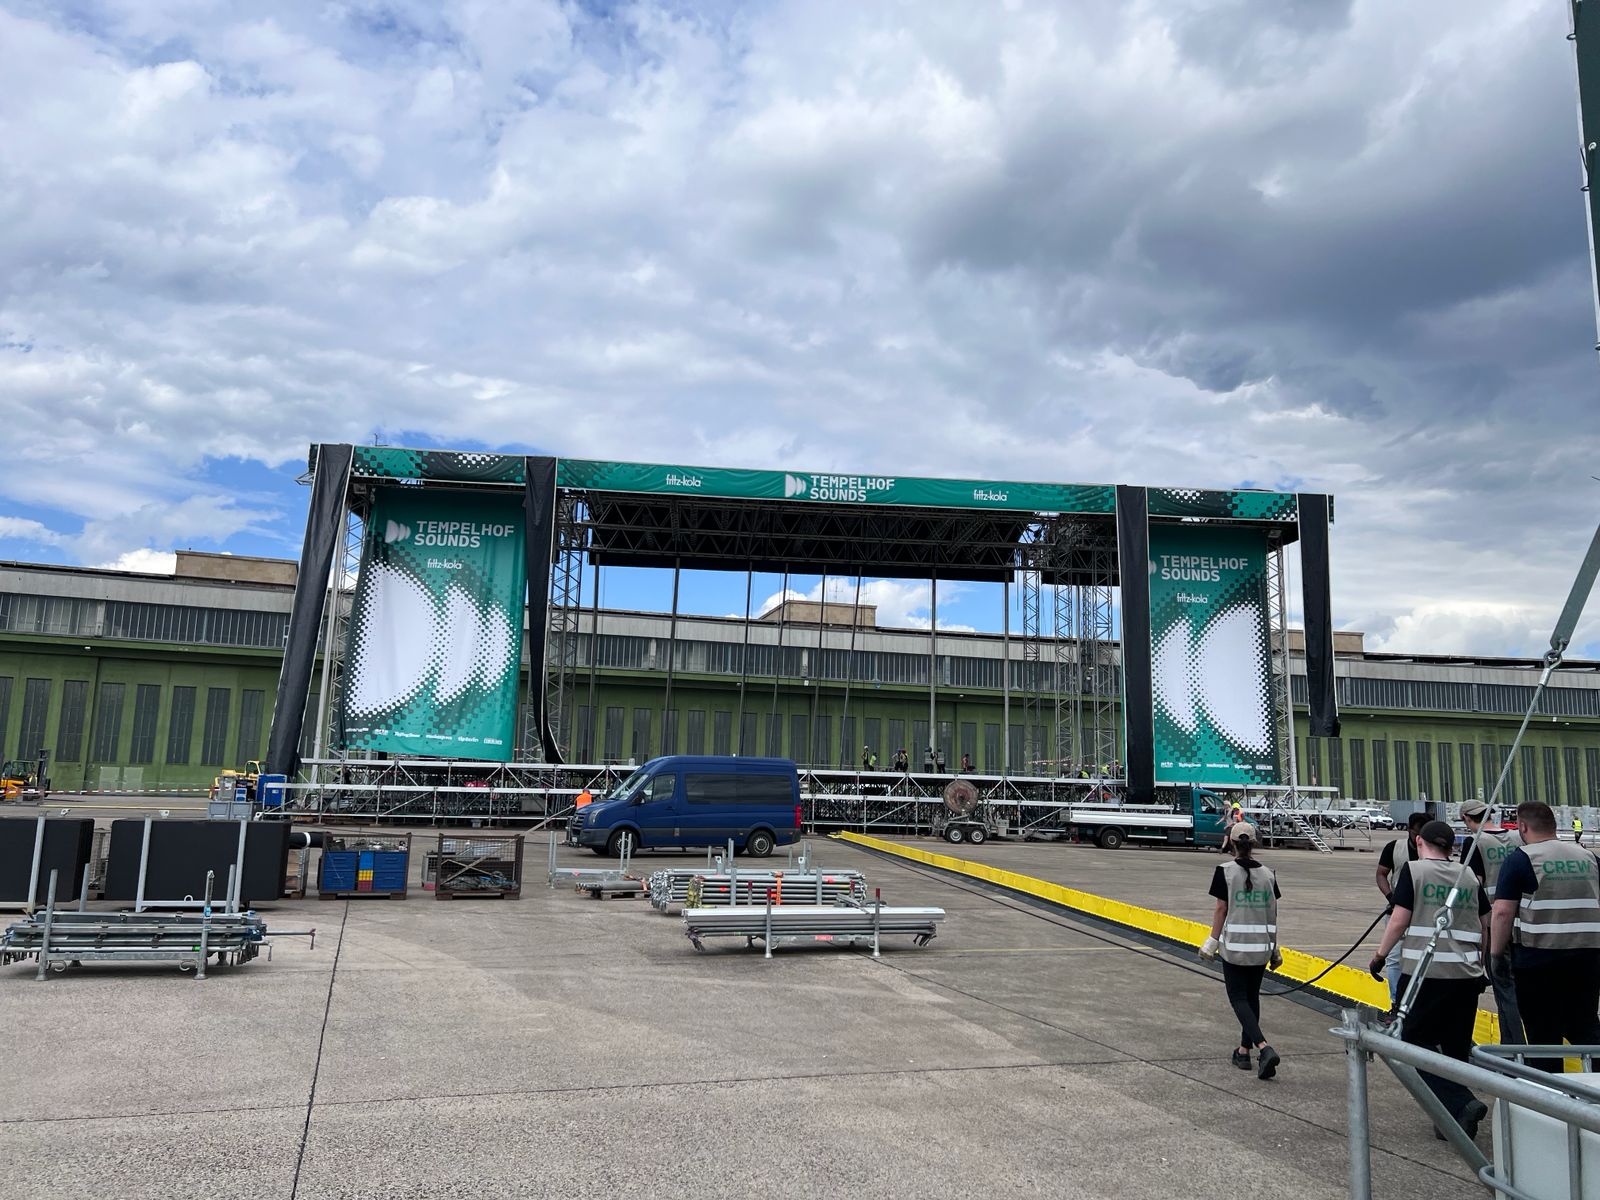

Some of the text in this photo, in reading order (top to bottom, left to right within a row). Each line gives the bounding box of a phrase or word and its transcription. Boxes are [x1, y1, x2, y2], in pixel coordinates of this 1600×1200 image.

[665, 474, 702, 487] fritz-kola
[810, 475, 896, 491] TEMPELHOF
[809, 487, 867, 502] SOUNDS
[973, 489, 1008, 502] fritz-kola
[416, 520, 515, 538] TEMPELHOF
[413, 533, 481, 548] SOUNDS
[427, 558, 463, 570] fritz-kola
[1160, 554, 1249, 570] TEMPELHOF
[1161, 567, 1221, 582] SOUNDS
[1176, 592, 1208, 604] fritz-kola
[1477, 787, 1485, 799] 5
[1486, 845, 1518, 860] CRE
[1542, 860, 1592, 874] CREW
[1423, 883, 1474, 903] CRW
